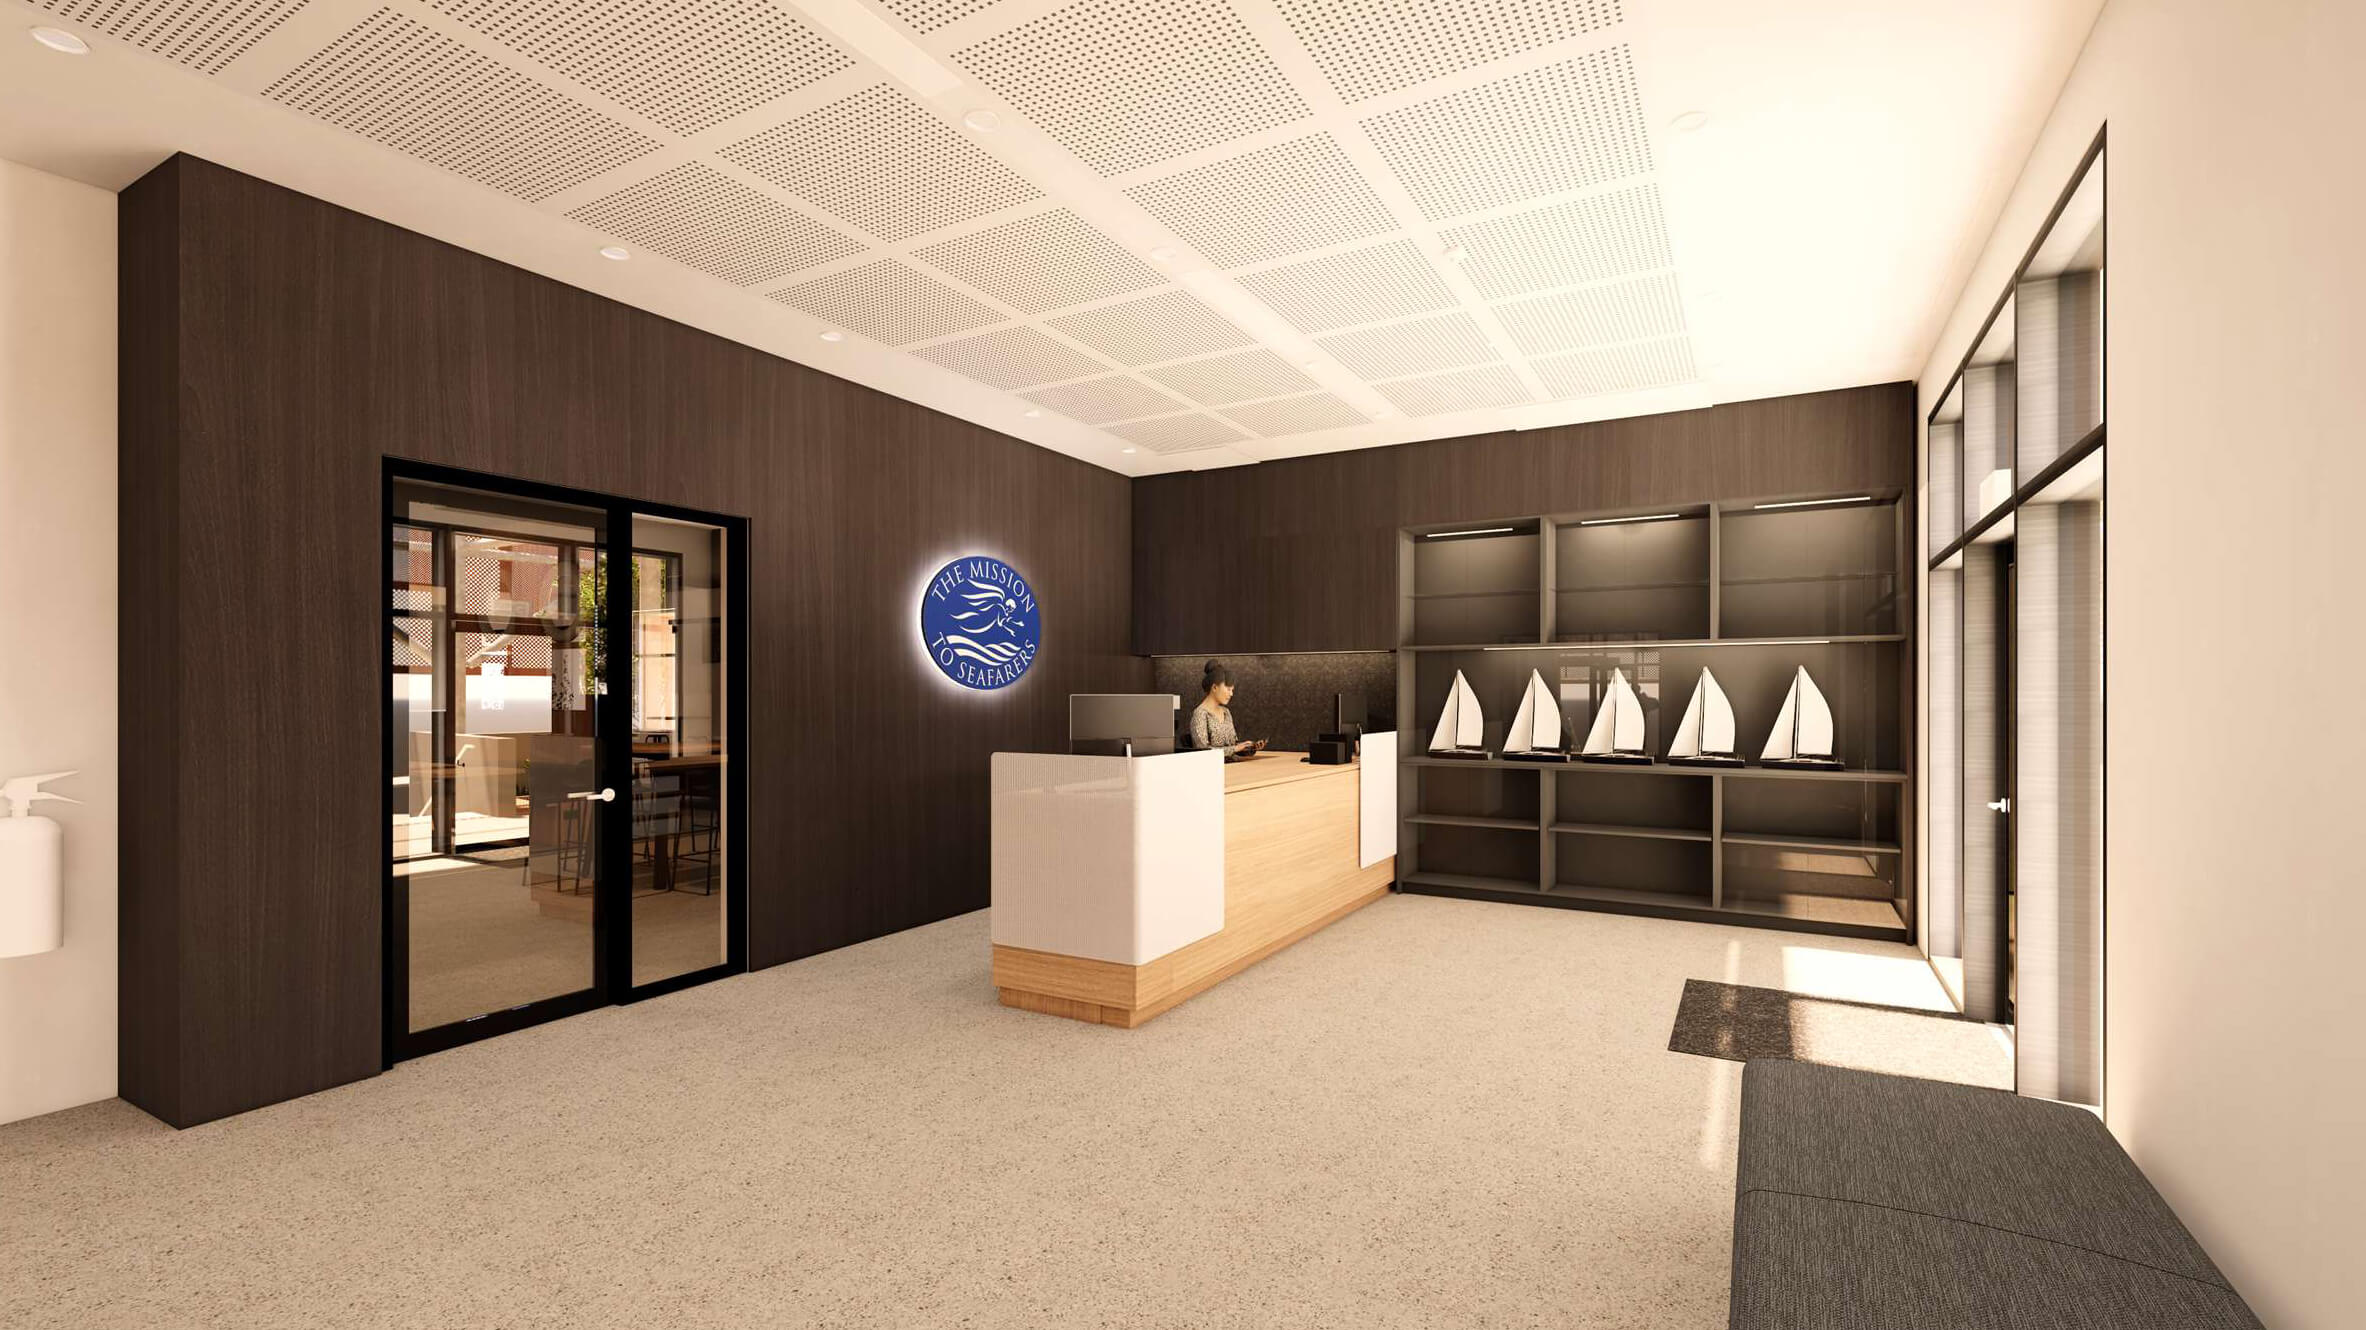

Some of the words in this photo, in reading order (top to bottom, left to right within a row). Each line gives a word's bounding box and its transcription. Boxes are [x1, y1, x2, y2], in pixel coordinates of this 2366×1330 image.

[932, 565, 965, 601] THE
[970, 561, 1035, 613] MISSION
[932, 632, 954, 666] TO
[957, 639, 1036, 687] SEAFARERS
